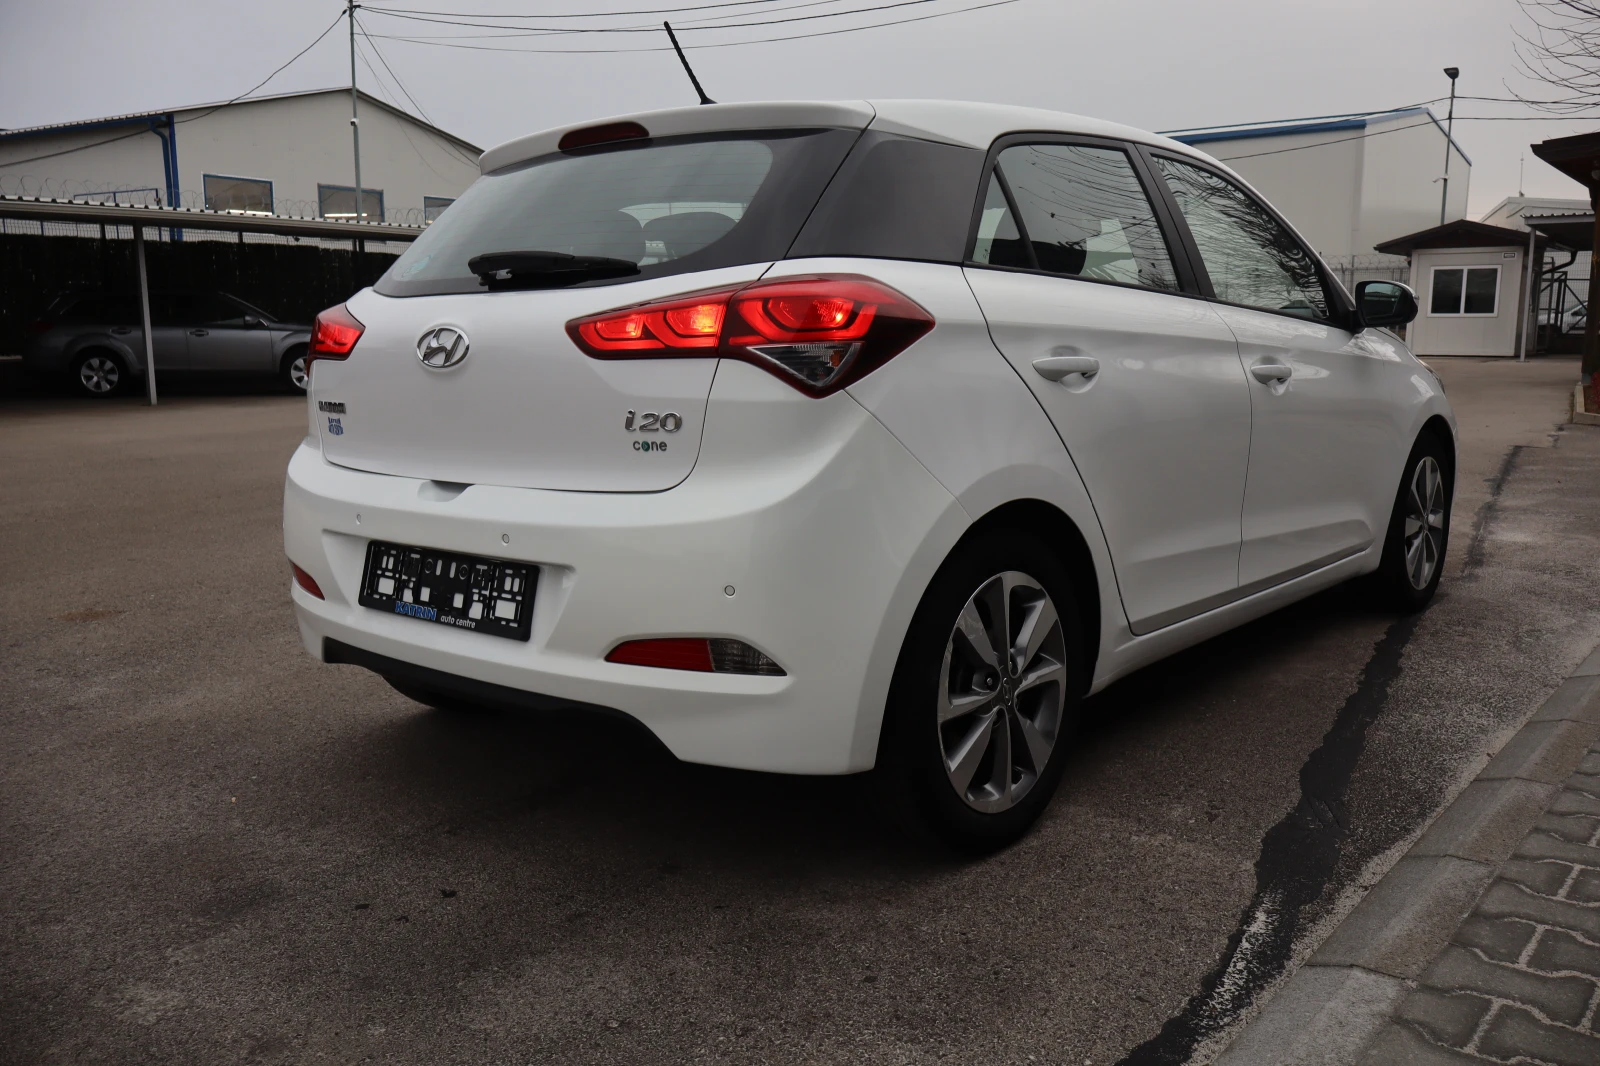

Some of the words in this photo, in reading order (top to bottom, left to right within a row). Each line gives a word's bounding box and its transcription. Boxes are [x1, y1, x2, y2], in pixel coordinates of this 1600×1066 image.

[625, 409, 682, 433] i20
[395, 601, 437, 621] KATRIN
[441, 615, 455, 624] auto
[456, 619, 476, 629] centre
